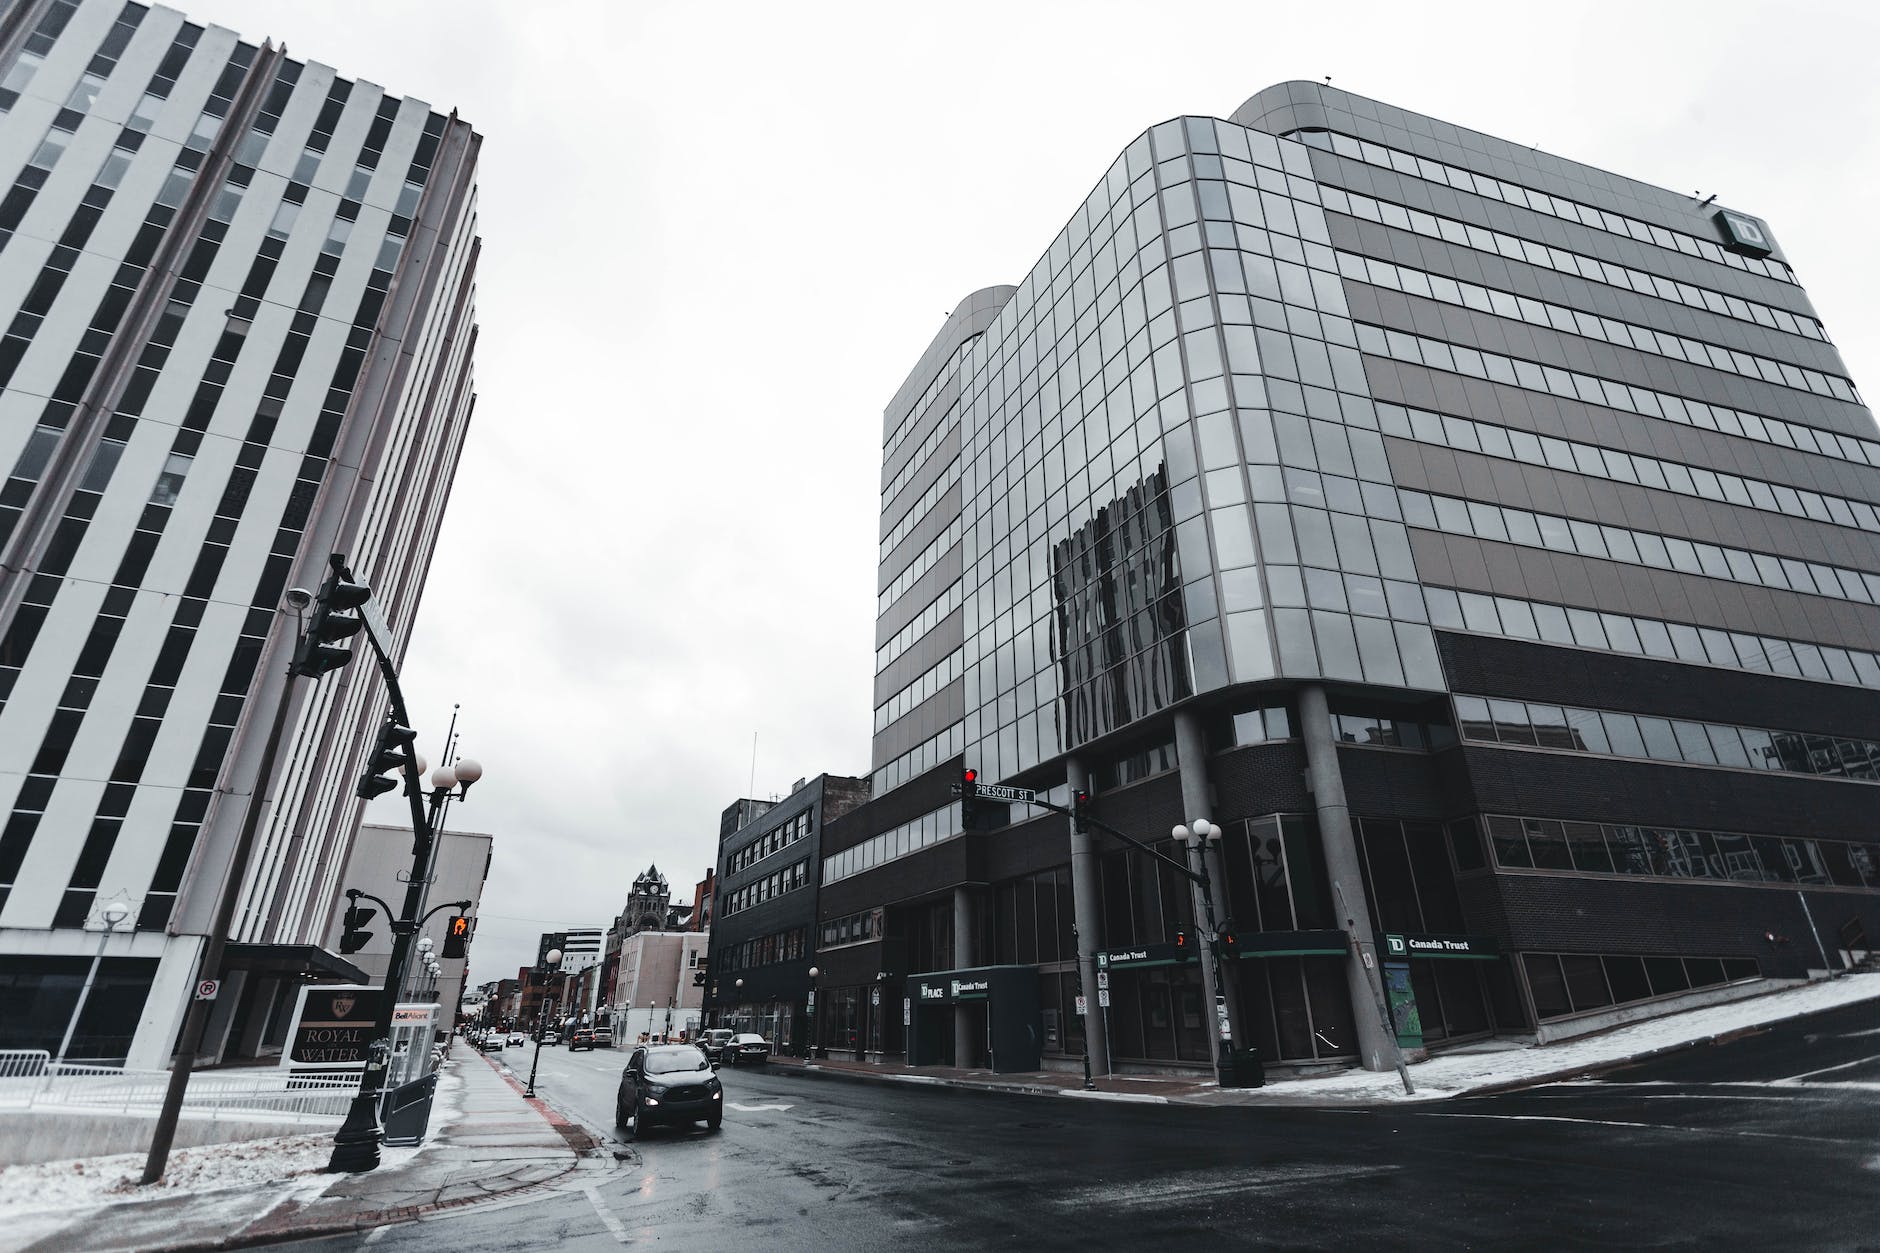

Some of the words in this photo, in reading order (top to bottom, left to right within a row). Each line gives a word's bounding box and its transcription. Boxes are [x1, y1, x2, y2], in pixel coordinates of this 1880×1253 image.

[1727, 217, 1763, 243] TD
[976, 785, 1015, 799] PRESCOTT
[1018, 790, 1029, 800] ST
[1388, 938, 1404, 951] TD
[1409, 939, 1443, 950] Canada
[1444, 941, 1470, 951] Trust
[1109, 952, 1131, 962] Canada
[1131, 950, 1147, 959] Trust
[958, 983, 975, 991] Canada
[975, 981, 988, 990] Trust
[928, 988, 943, 998] PLACE
[306, 1029, 361, 1043] ROYAL
[300, 1048, 359, 1062] WATER
